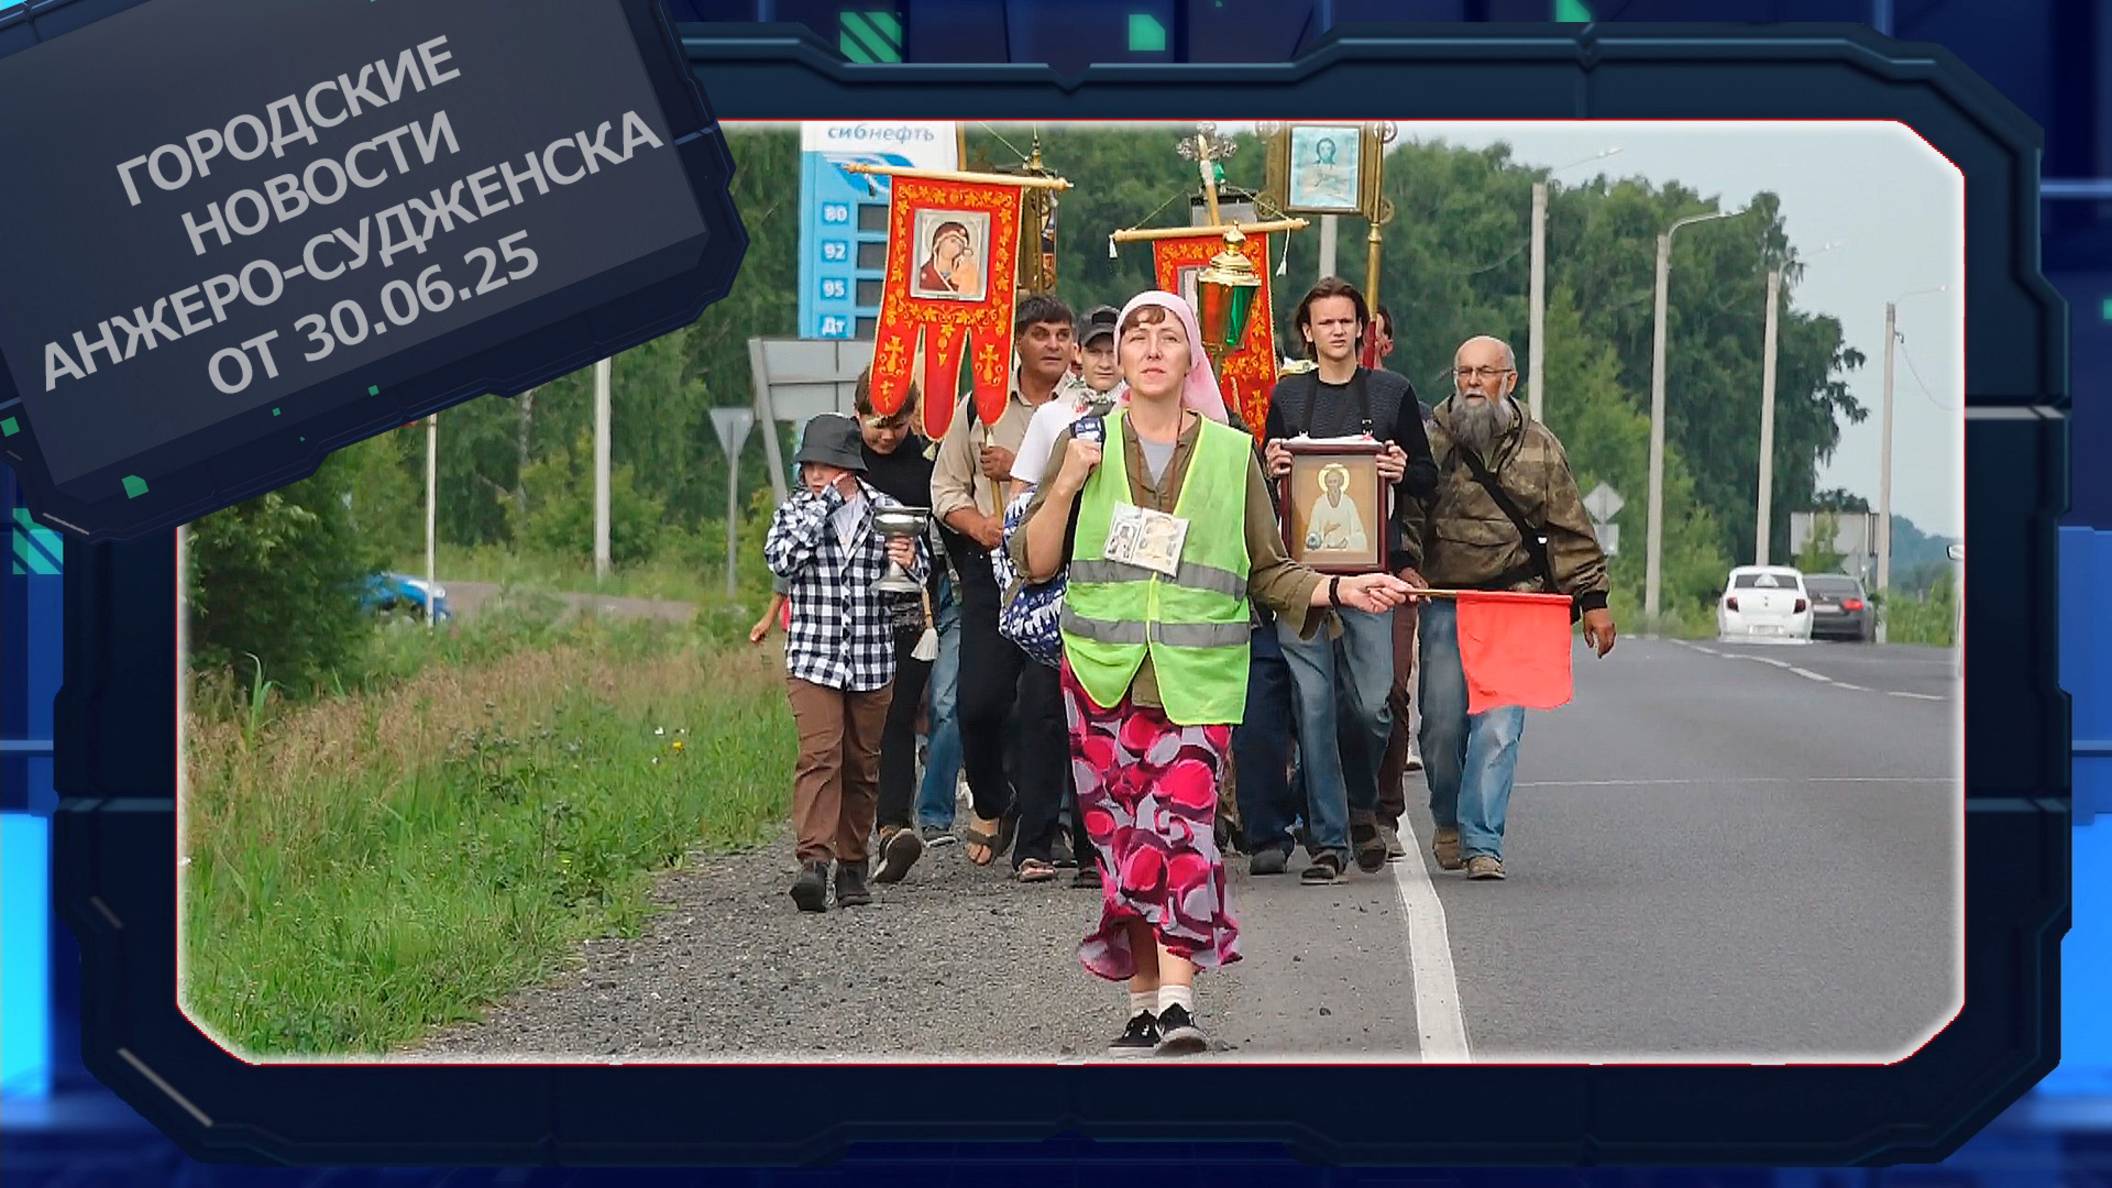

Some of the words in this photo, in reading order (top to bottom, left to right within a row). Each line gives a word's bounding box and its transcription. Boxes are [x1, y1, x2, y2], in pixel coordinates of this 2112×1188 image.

[827, 124, 935, 145] сибнефть
[823, 204, 848, 222] 80
[823, 242, 847, 260] 92
[822, 280, 845, 298] 95
[822, 317, 846, 336] Дт
